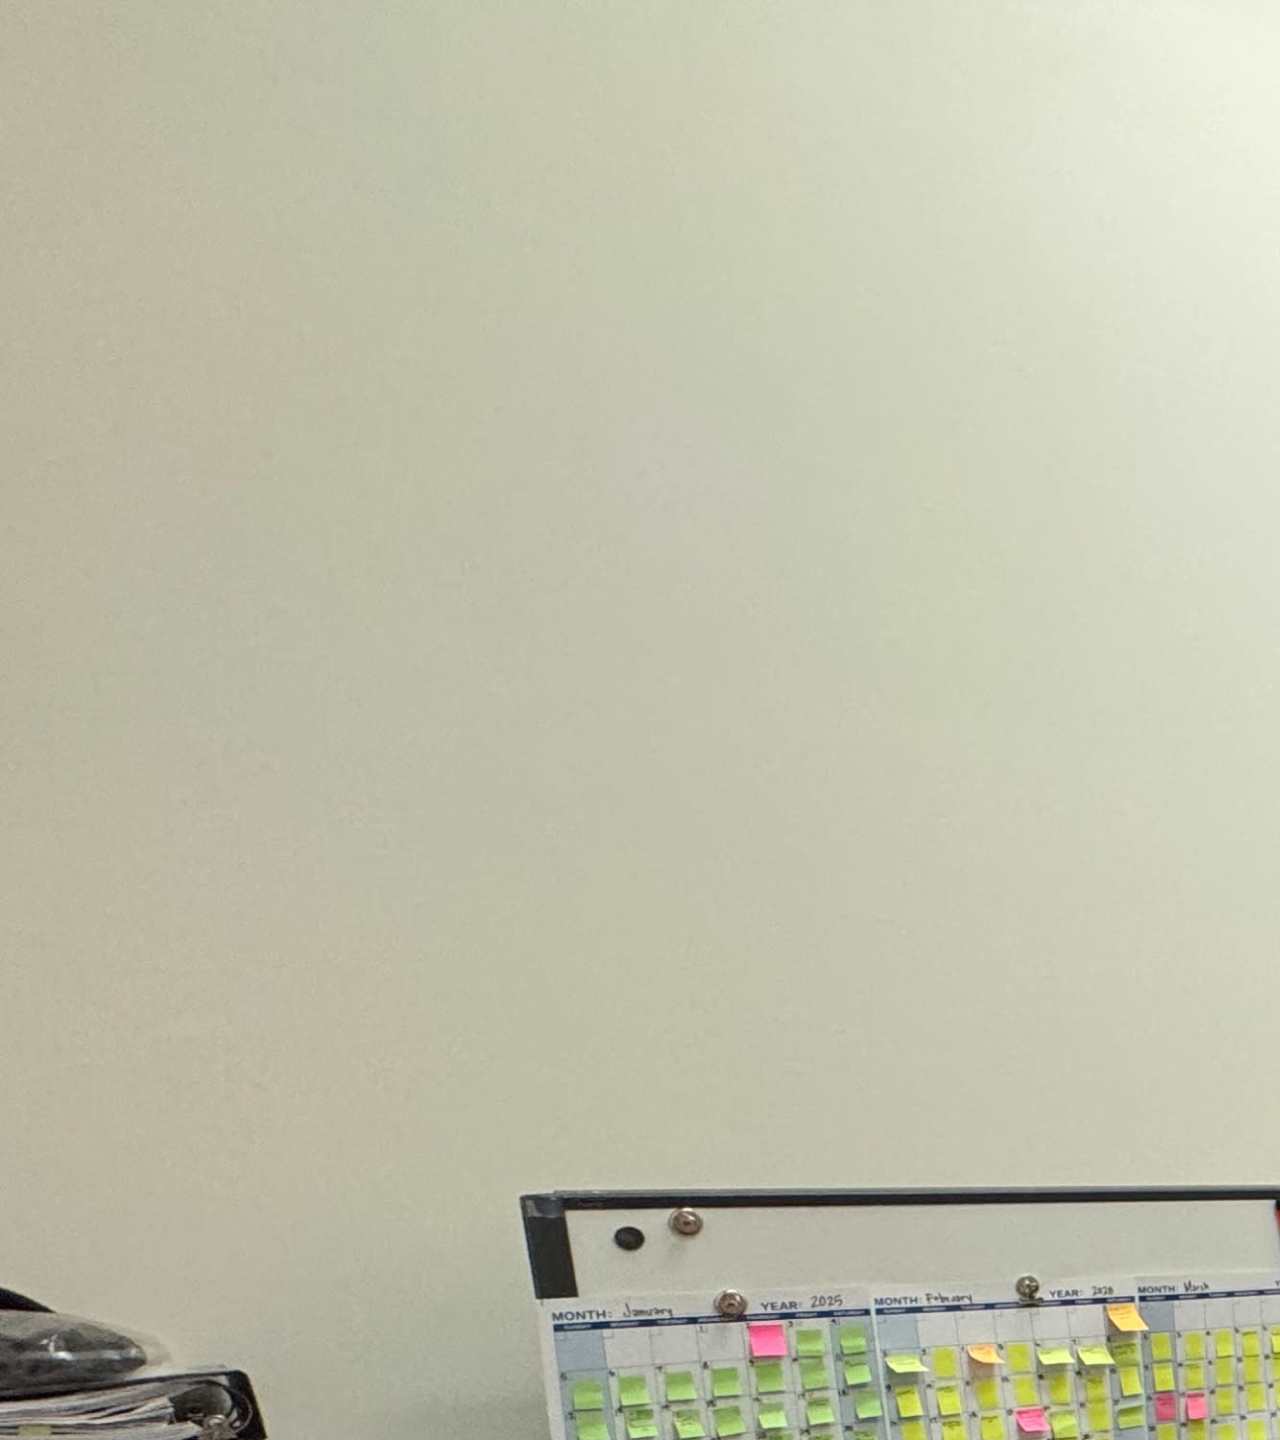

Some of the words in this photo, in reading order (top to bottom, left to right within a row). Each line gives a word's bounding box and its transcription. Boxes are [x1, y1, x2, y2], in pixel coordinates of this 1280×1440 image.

[552, 1309, 613, 1322] MONTH:
[810, 1295, 843, 1308] 2025
[873, 1296, 921, 1306] MONTH:
